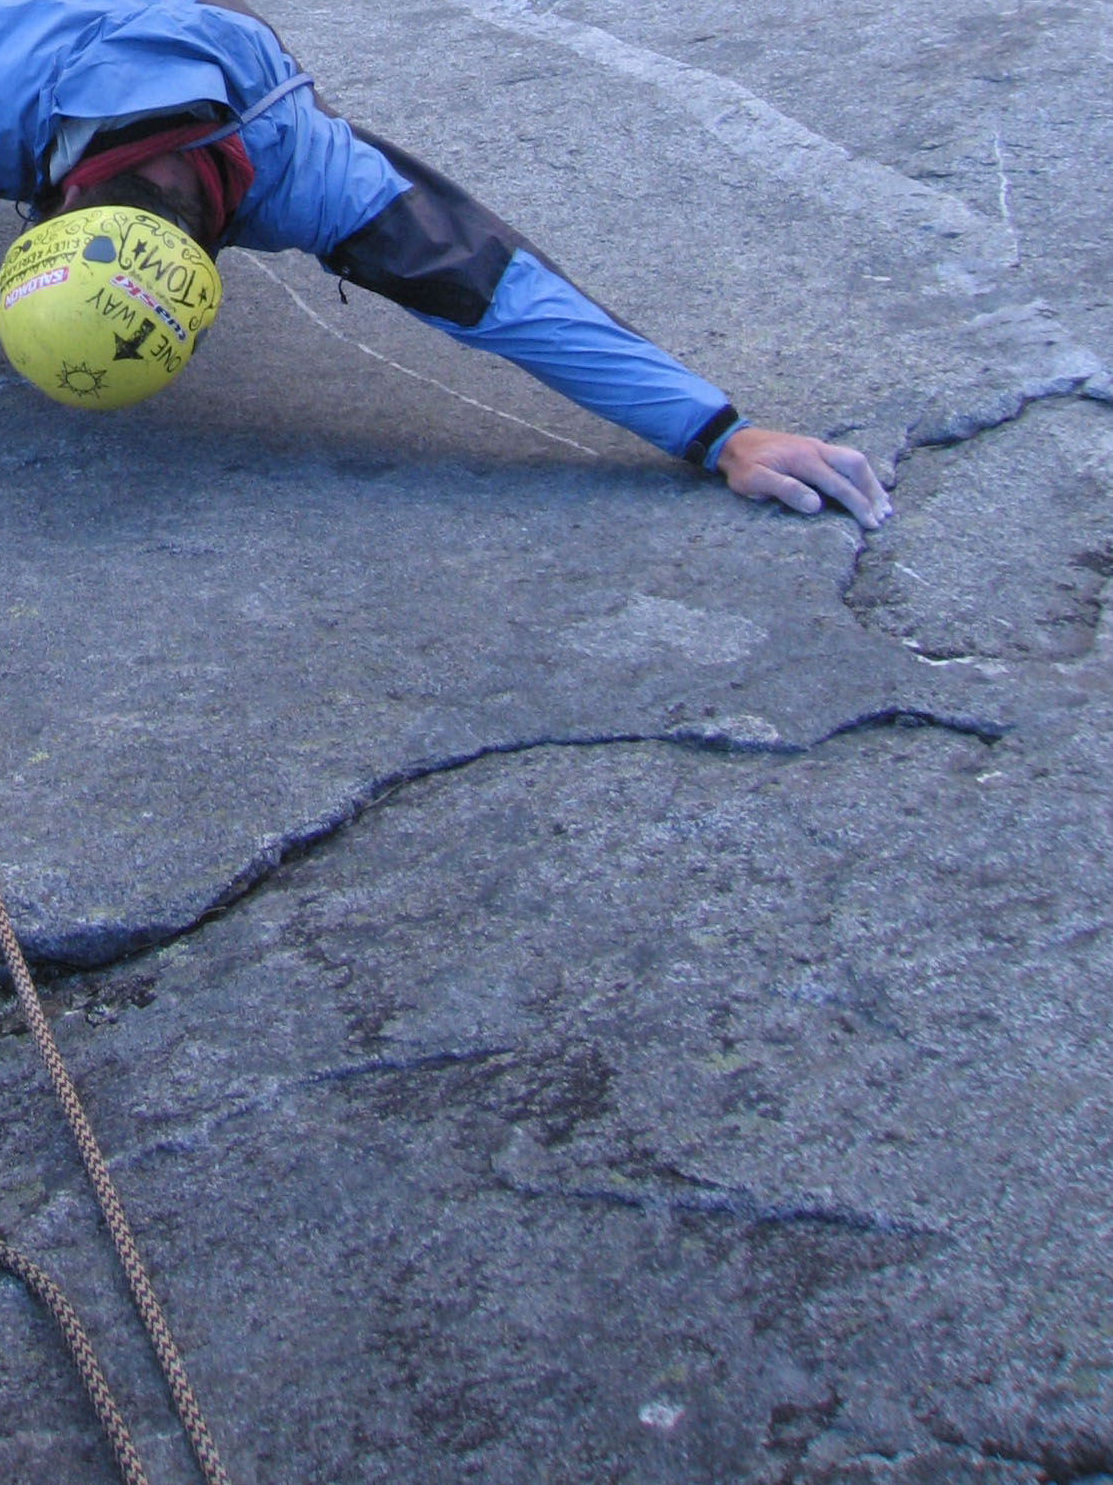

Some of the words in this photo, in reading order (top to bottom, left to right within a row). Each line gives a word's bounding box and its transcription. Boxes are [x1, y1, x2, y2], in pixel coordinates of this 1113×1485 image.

[4, 267, 66, 308] SALOMON
[138, 244, 197, 307] TOM
[85, 287, 135, 330] WAY
[150, 333, 182, 374] ONE
